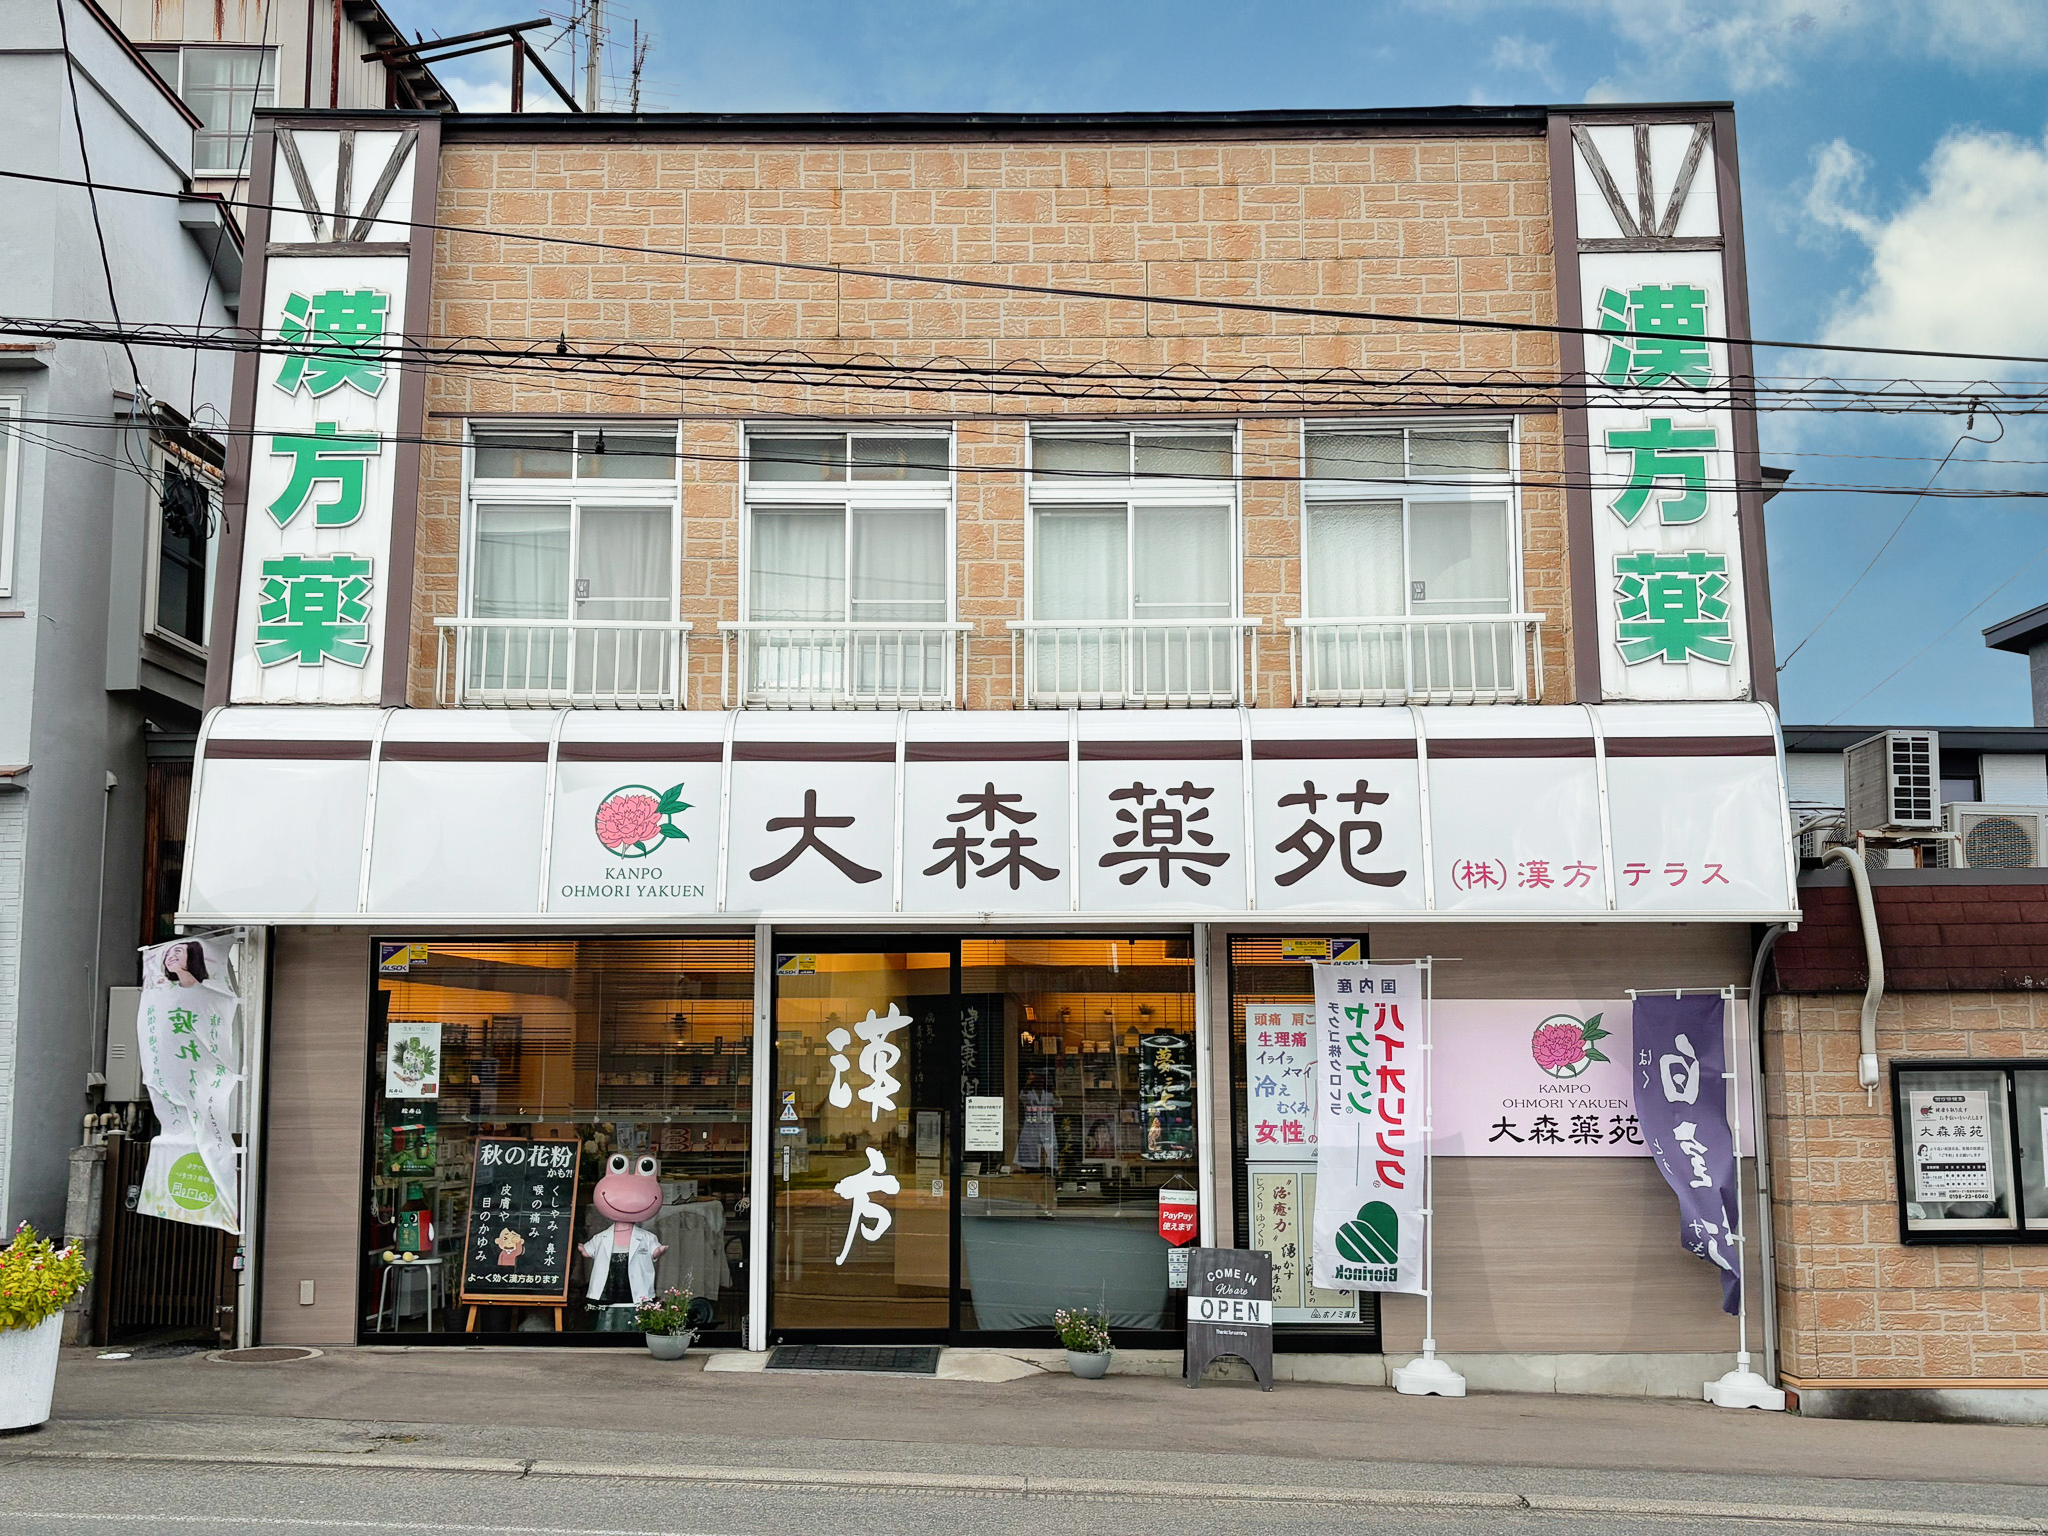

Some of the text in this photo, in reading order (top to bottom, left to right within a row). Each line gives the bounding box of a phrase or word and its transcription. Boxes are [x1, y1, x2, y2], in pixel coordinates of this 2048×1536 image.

[254, 287, 390, 669] 漢方薬
[1597, 282, 1736, 666] 漢方薬
[749, 779, 1407, 890] 大森薬苑
[604, 867, 664, 881] KANPO
[561, 884, 705, 898] OHMORI YAKUEN
[1254, 1012, 1282, 1026] 頭痛
[1257, 1031, 1308, 1048] 生理痛
[1256, 1050, 1295, 1065] イライラ
[1281, 1066, 1312, 1079] メマイ
[1254, 1074, 1291, 1098] 冷え
[1538, 1084, 1591, 1094] KAMPO
[1276, 1101, 1310, 1115] むくみ
[1502, 1098, 1629, 1109] OHMORI YAKUEN
[825, 1001, 914, 1267] 漢方
[1488, 1113, 1645, 1145] 大森薬苑
[1919, 1125, 1984, 1138] 大森薬苑
[479, 1143, 574, 1168] 秋の花粉
[498, 1183, 512, 1223] 皮膚や
[528, 1184, 544, 1238] 喉の痛み
[1162, 1211, 1194, 1221] PayPay
[475, 1197, 491, 1262] 目のかゆみ
[1162, 1222, 1194, 1231] 使えます
[1206, 1268, 1258, 1287] COME IN
[1215, 1282, 1234, 1295] We
[1200, 1298, 1260, 1322] OPEN
